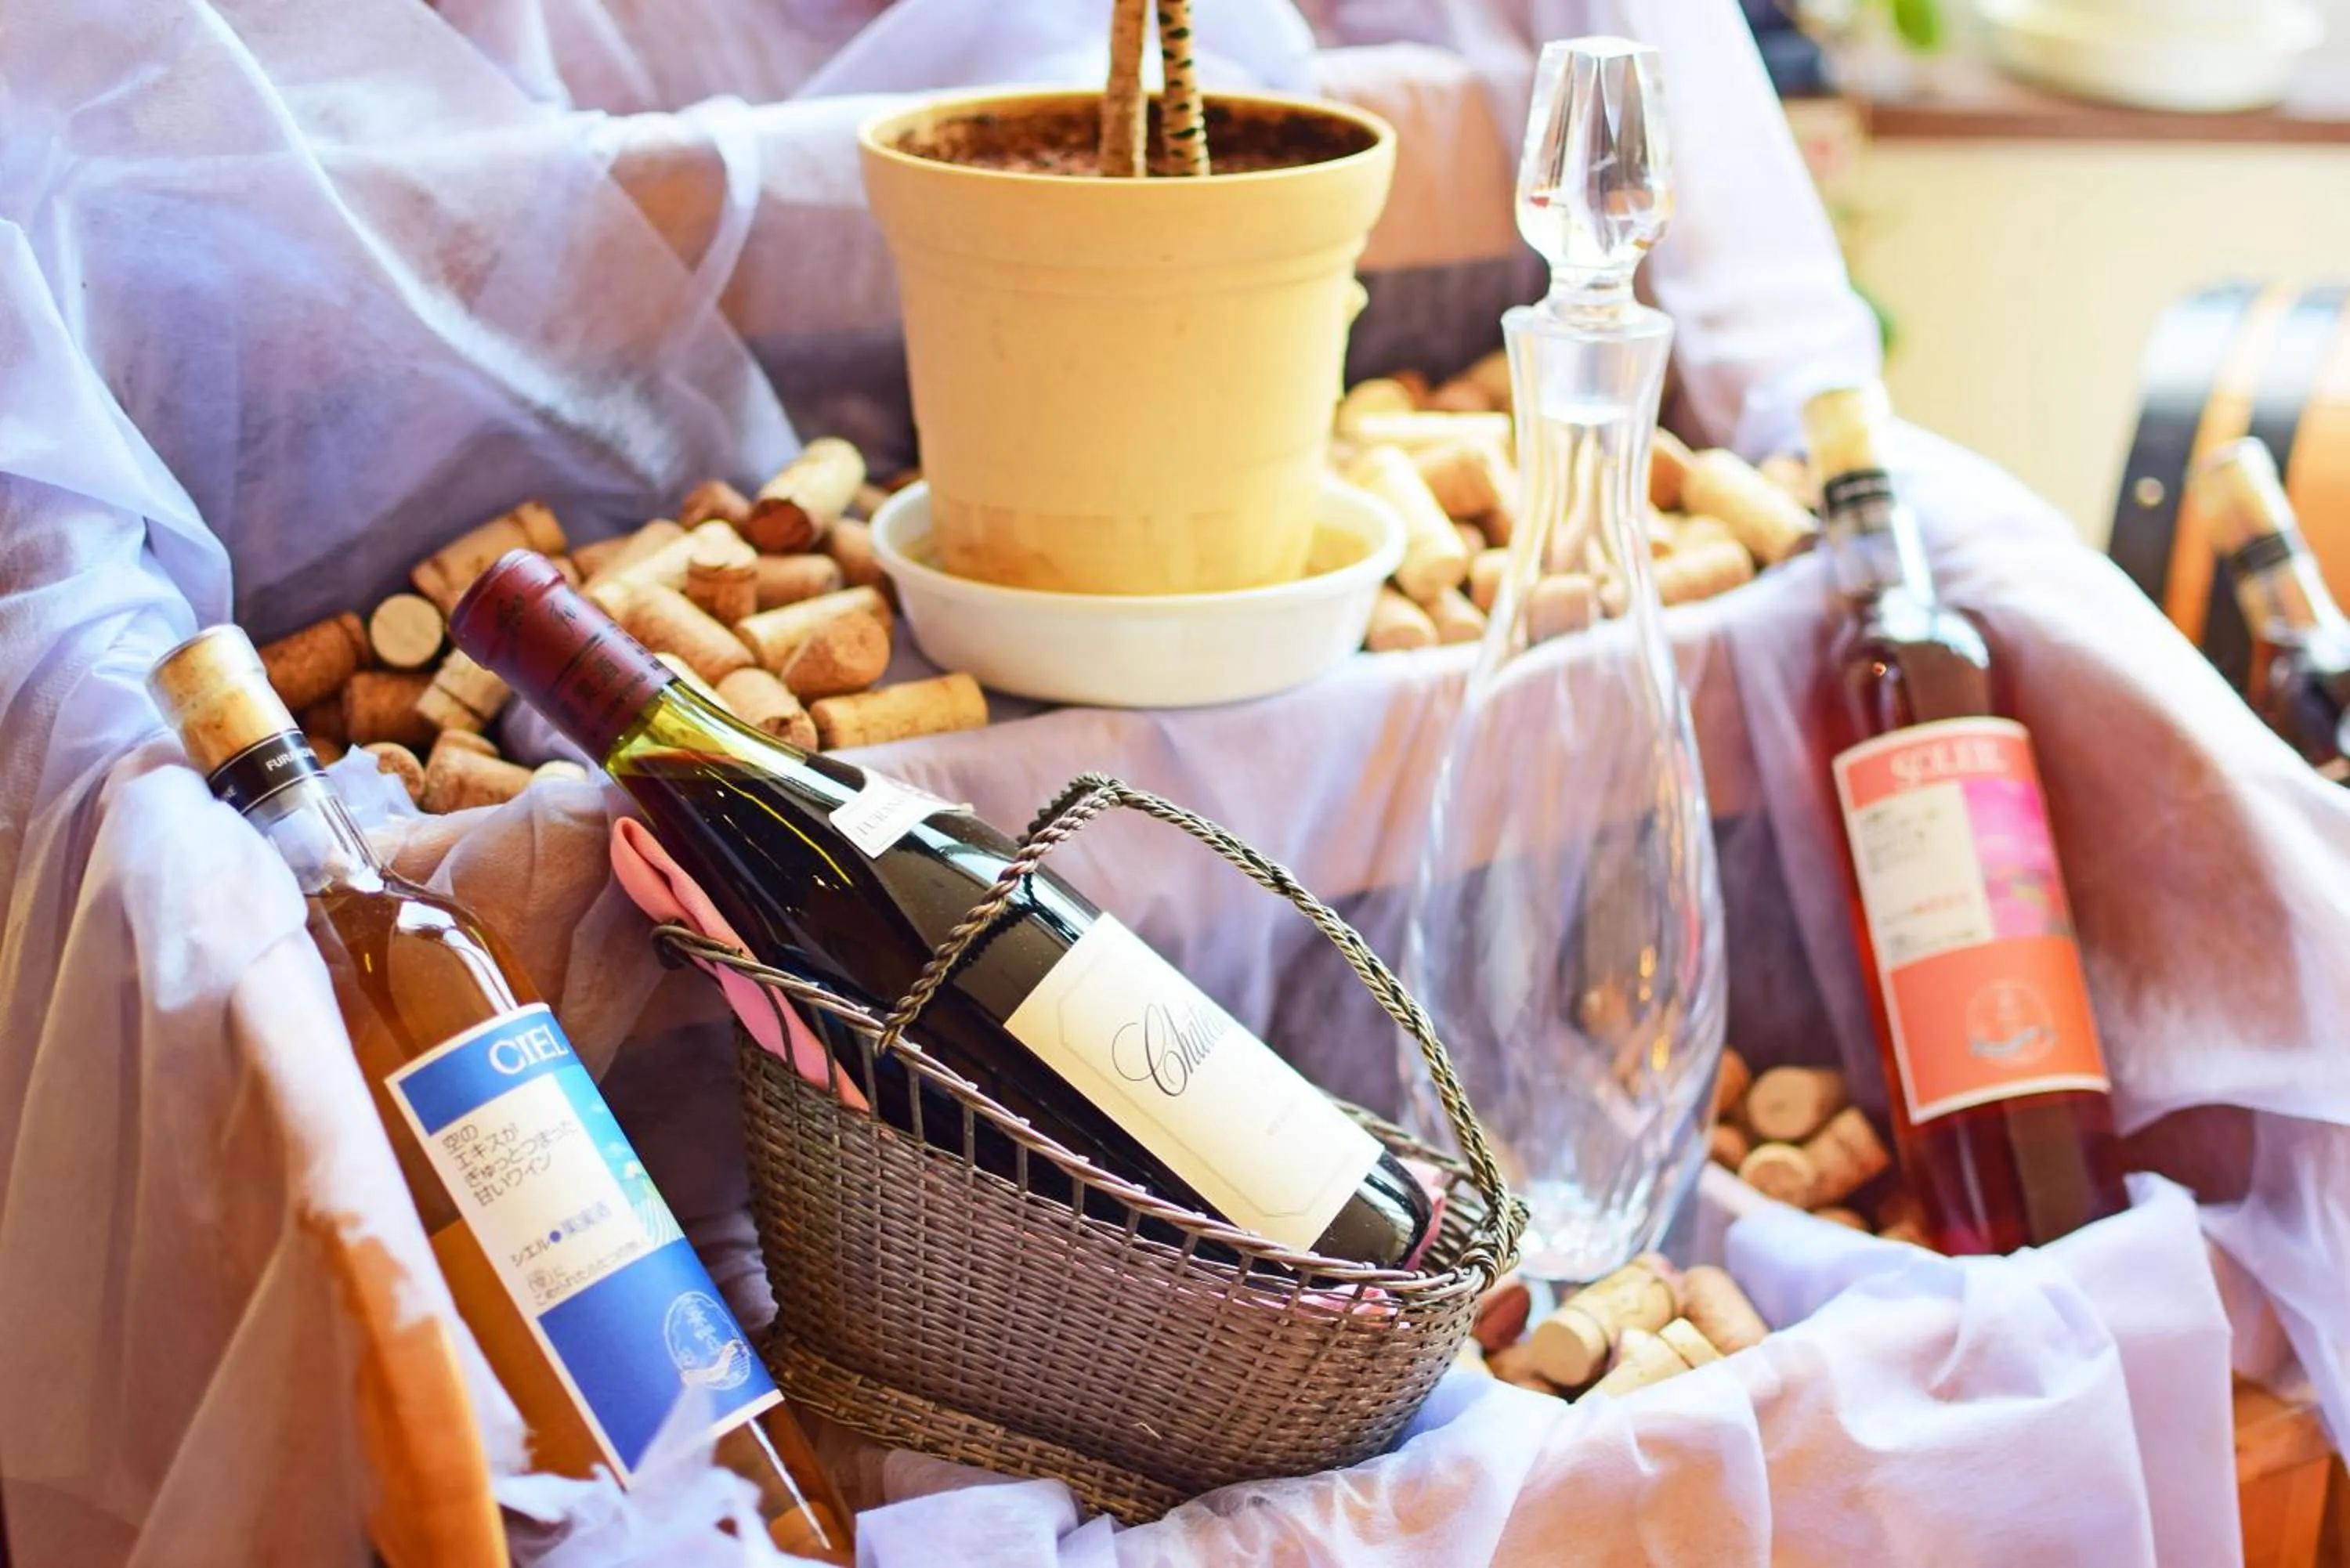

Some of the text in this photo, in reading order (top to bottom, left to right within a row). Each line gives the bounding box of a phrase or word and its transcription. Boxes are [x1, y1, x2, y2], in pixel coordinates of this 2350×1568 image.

[490, 1024, 569, 1074] CIEL
[442, 1124, 479, 1155] 空の
[454, 1122, 519, 1171] エキスが
[474, 1151, 551, 1206] 甘いワイン
